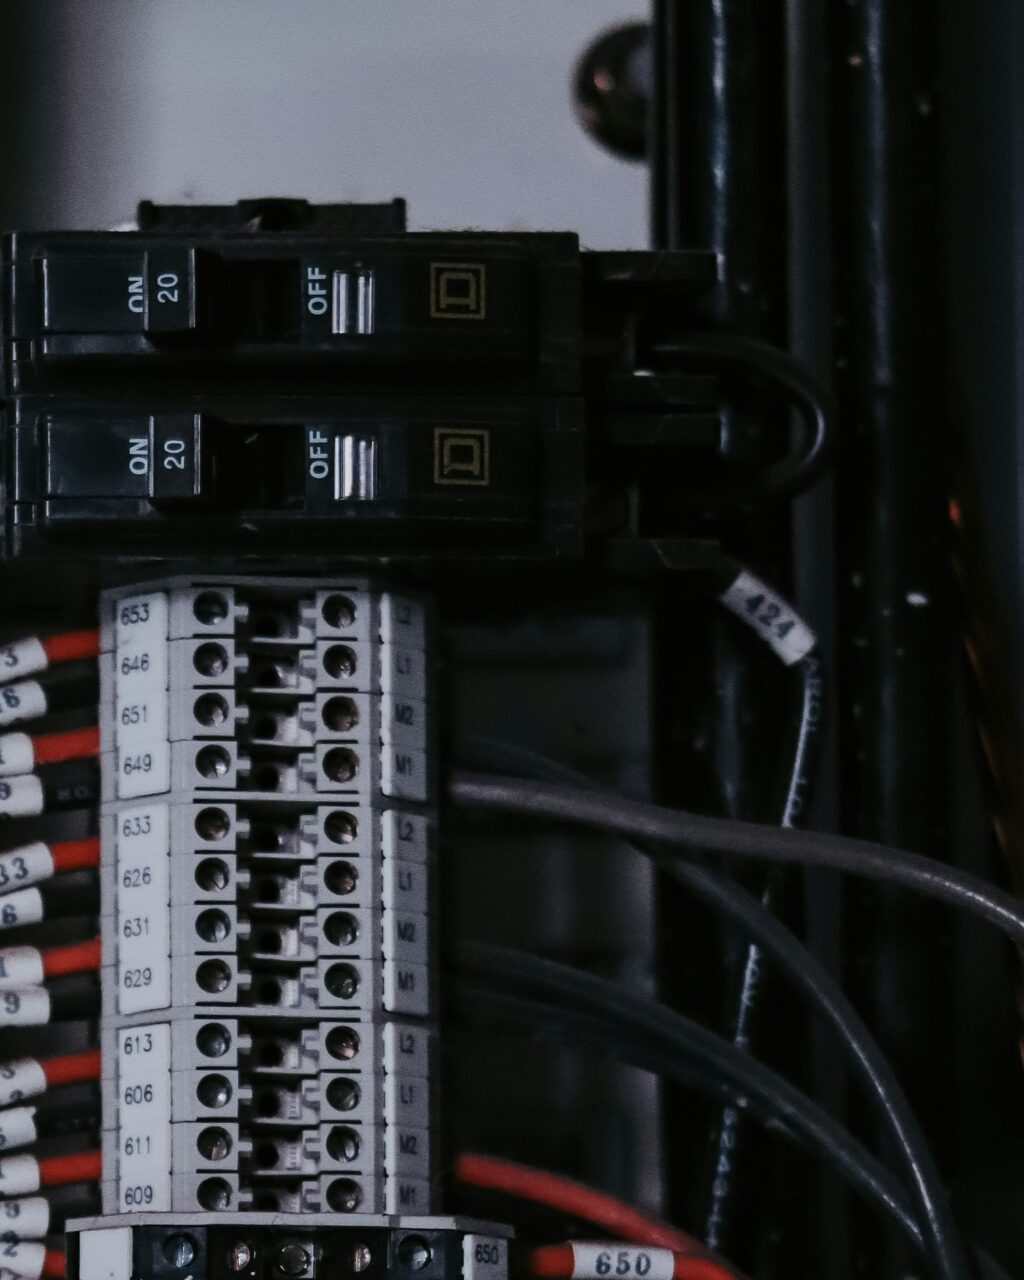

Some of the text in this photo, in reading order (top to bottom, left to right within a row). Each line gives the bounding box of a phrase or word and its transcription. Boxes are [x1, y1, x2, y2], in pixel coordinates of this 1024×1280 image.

[128, 276, 144, 313] ON
[157, 274, 178, 303] 20
[308, 268, 327, 314] OFF
[130, 438, 148, 475] ON
[164, 440, 184, 469] 20
[309, 431, 328, 478] OFF
[118, 601, 150, 625] 653
[121, 653, 149, 675] 646
[121, 705, 146, 725] 651
[124, 754, 151, 775] 649
[123, 816, 150, 837] 633
[123, 867, 151, 888] 626
[123, 918, 148, 938] 631
[124, 968, 152, 988] 629
[124, 1034, 152, 1054] 613
[125, 1084, 152, 1105] 606
[125, 1136, 150, 1155] 611
[125, 1186, 153, 1205] 609
[475, 1245, 499, 1264] 650
[596, 1252, 651, 1276] 650
